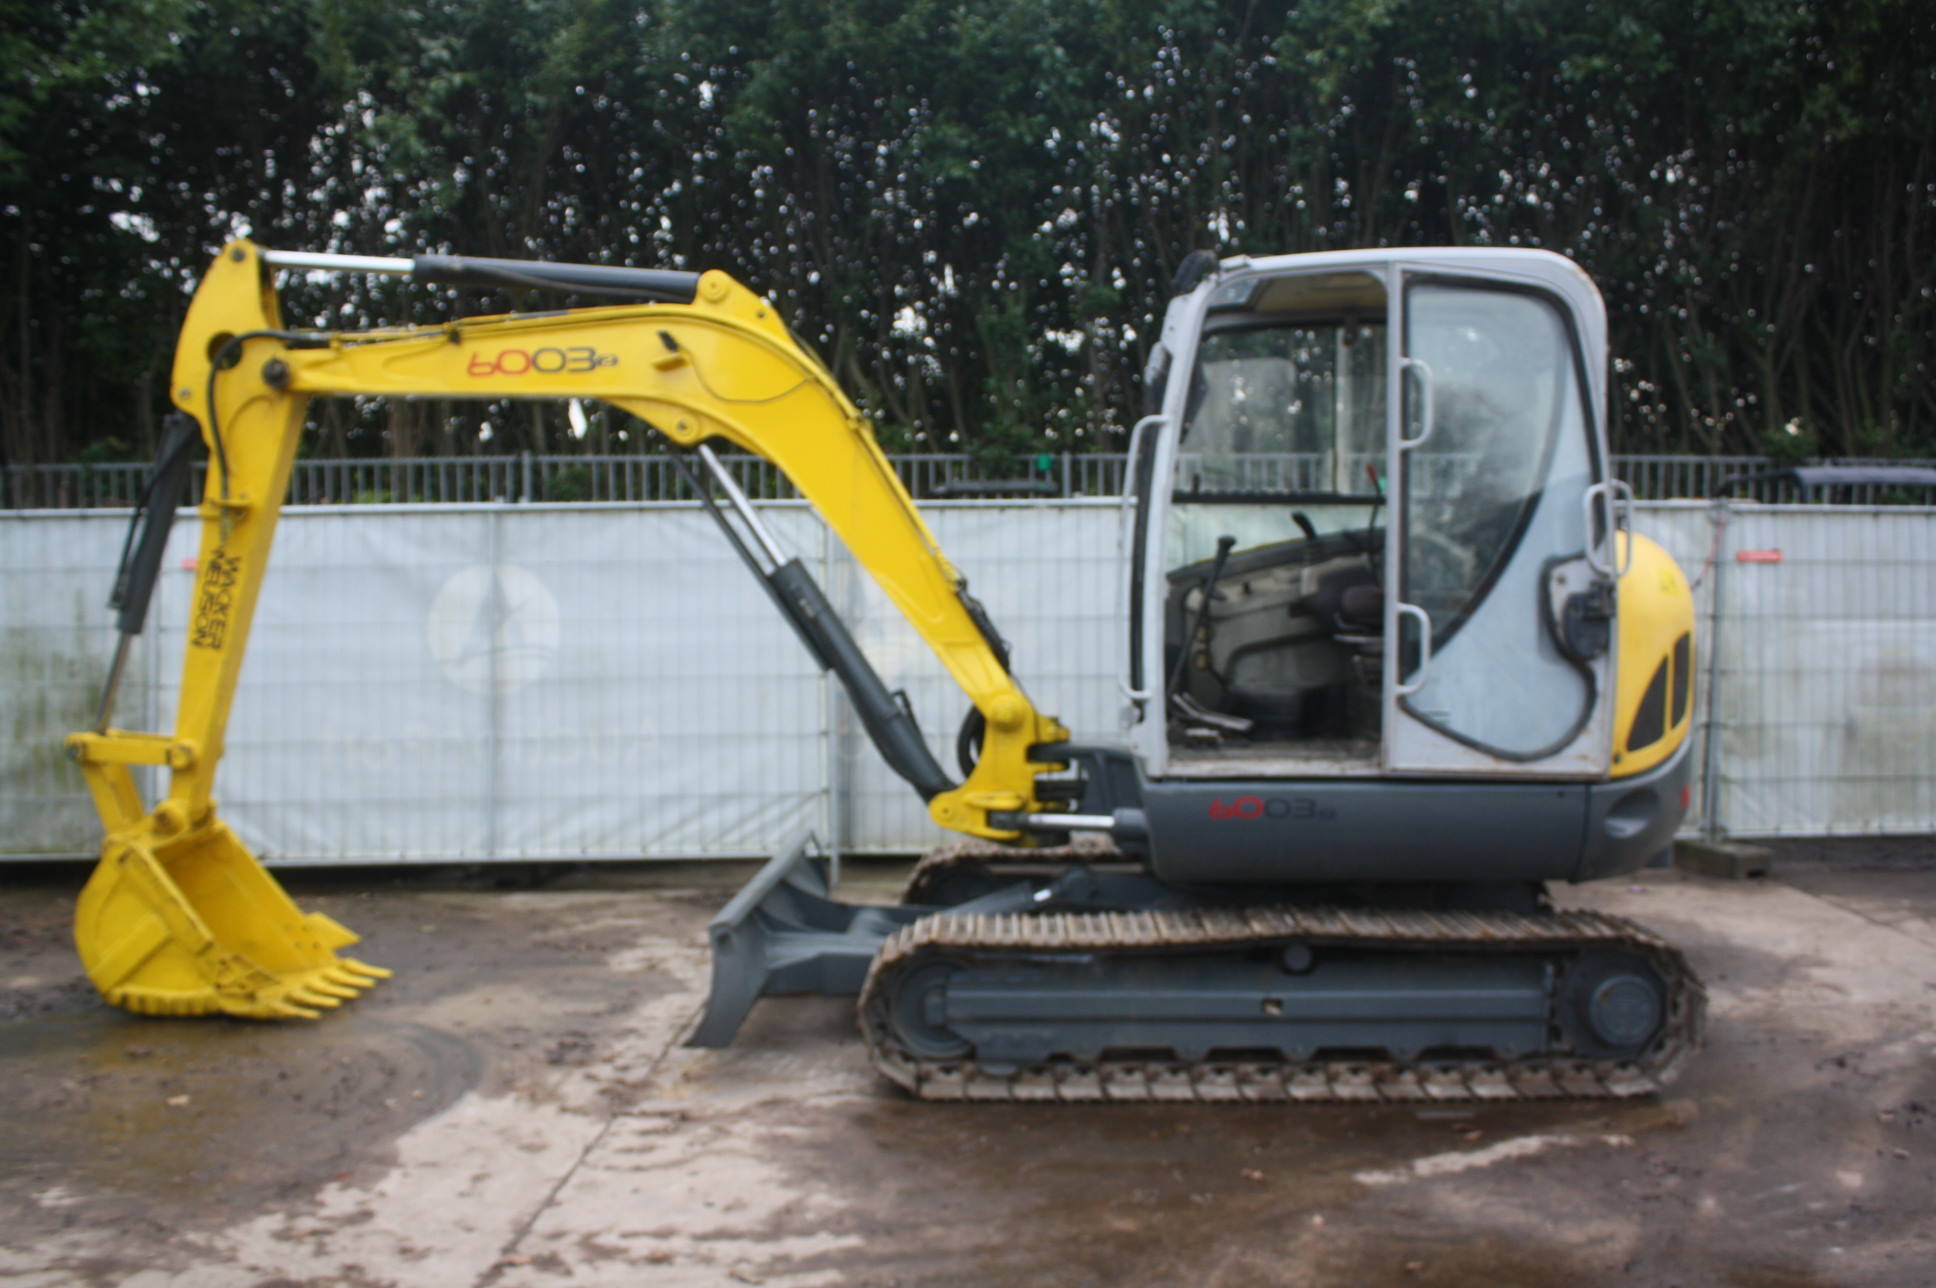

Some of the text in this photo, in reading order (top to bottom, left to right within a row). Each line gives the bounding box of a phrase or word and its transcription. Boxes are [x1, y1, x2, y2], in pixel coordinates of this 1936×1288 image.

[467, 347, 597, 376] 6003
[191, 547, 226, 649] NEUSON
[207, 556, 242, 650] WACKER
